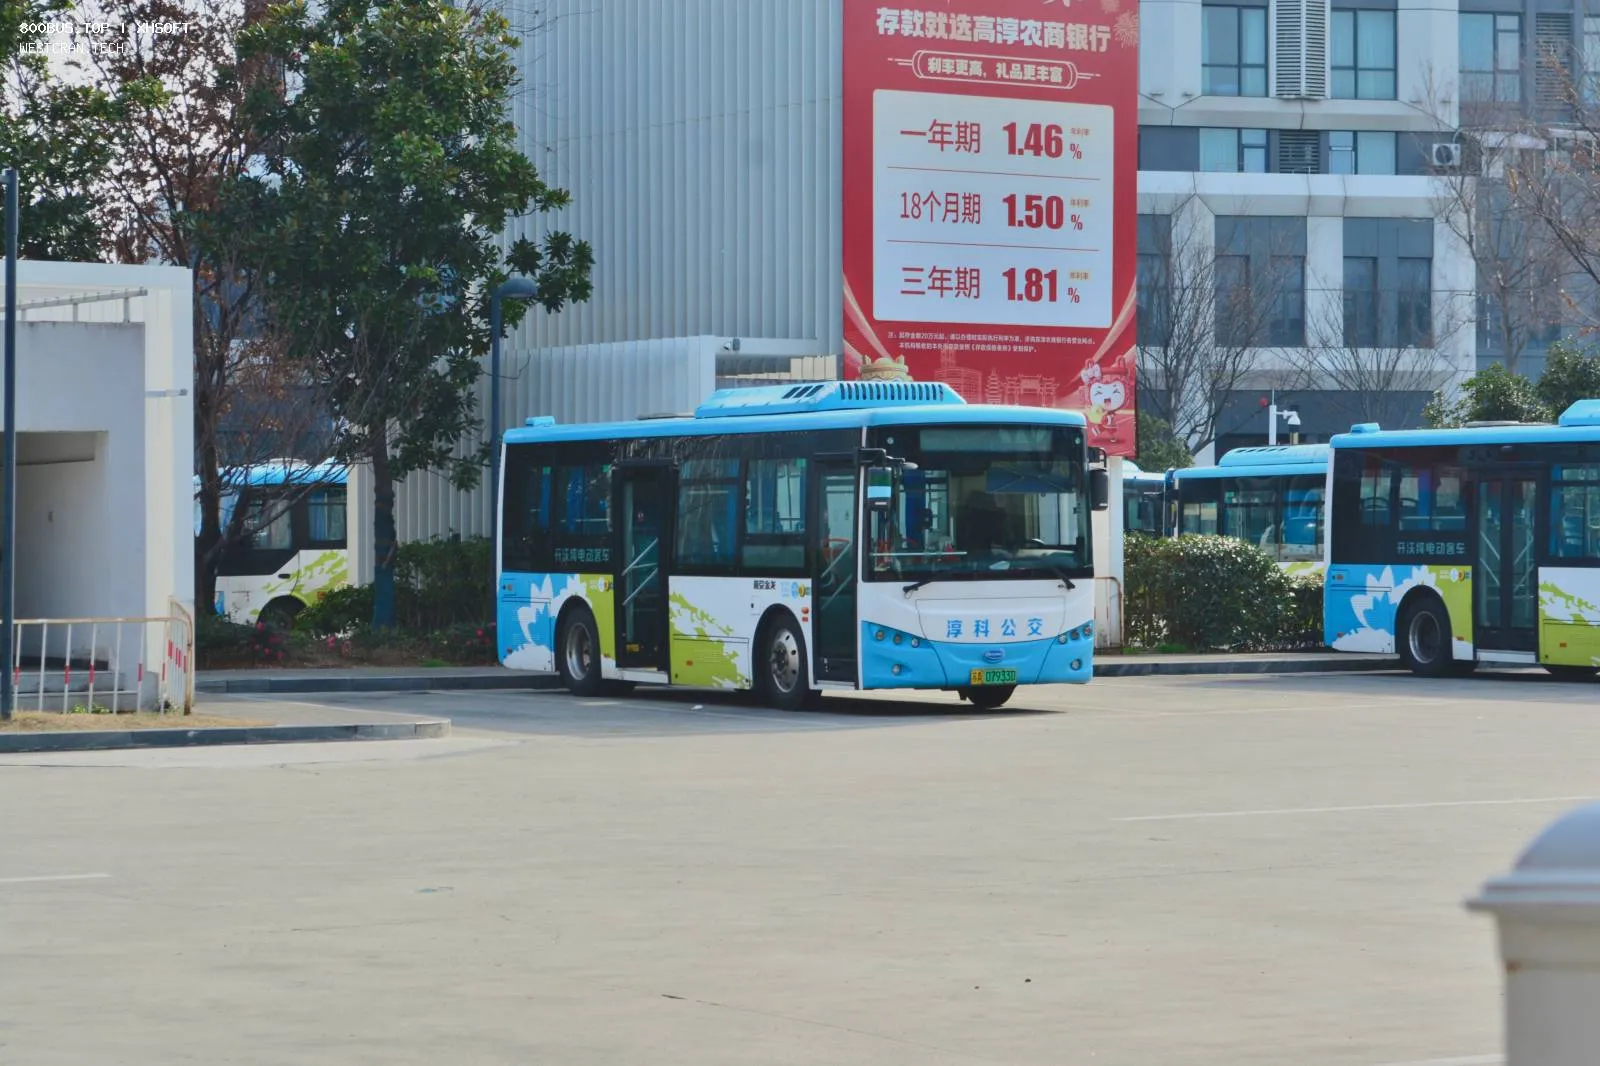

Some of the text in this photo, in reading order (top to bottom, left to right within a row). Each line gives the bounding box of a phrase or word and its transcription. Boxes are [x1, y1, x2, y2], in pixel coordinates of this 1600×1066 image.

[876, 7, 1112, 53] 存款就选高淳农商银行
[900, 119, 981, 154] 一年期
[1002, 121, 1064, 159] 1.46
[900, 191, 981, 225] 18个月期
[1002, 194, 1065, 230] 1.50
[900, 265, 981, 300] 三年期
[1002, 267, 1058, 303] 1.81
[946, 618, 1044, 638] 淳科公交
